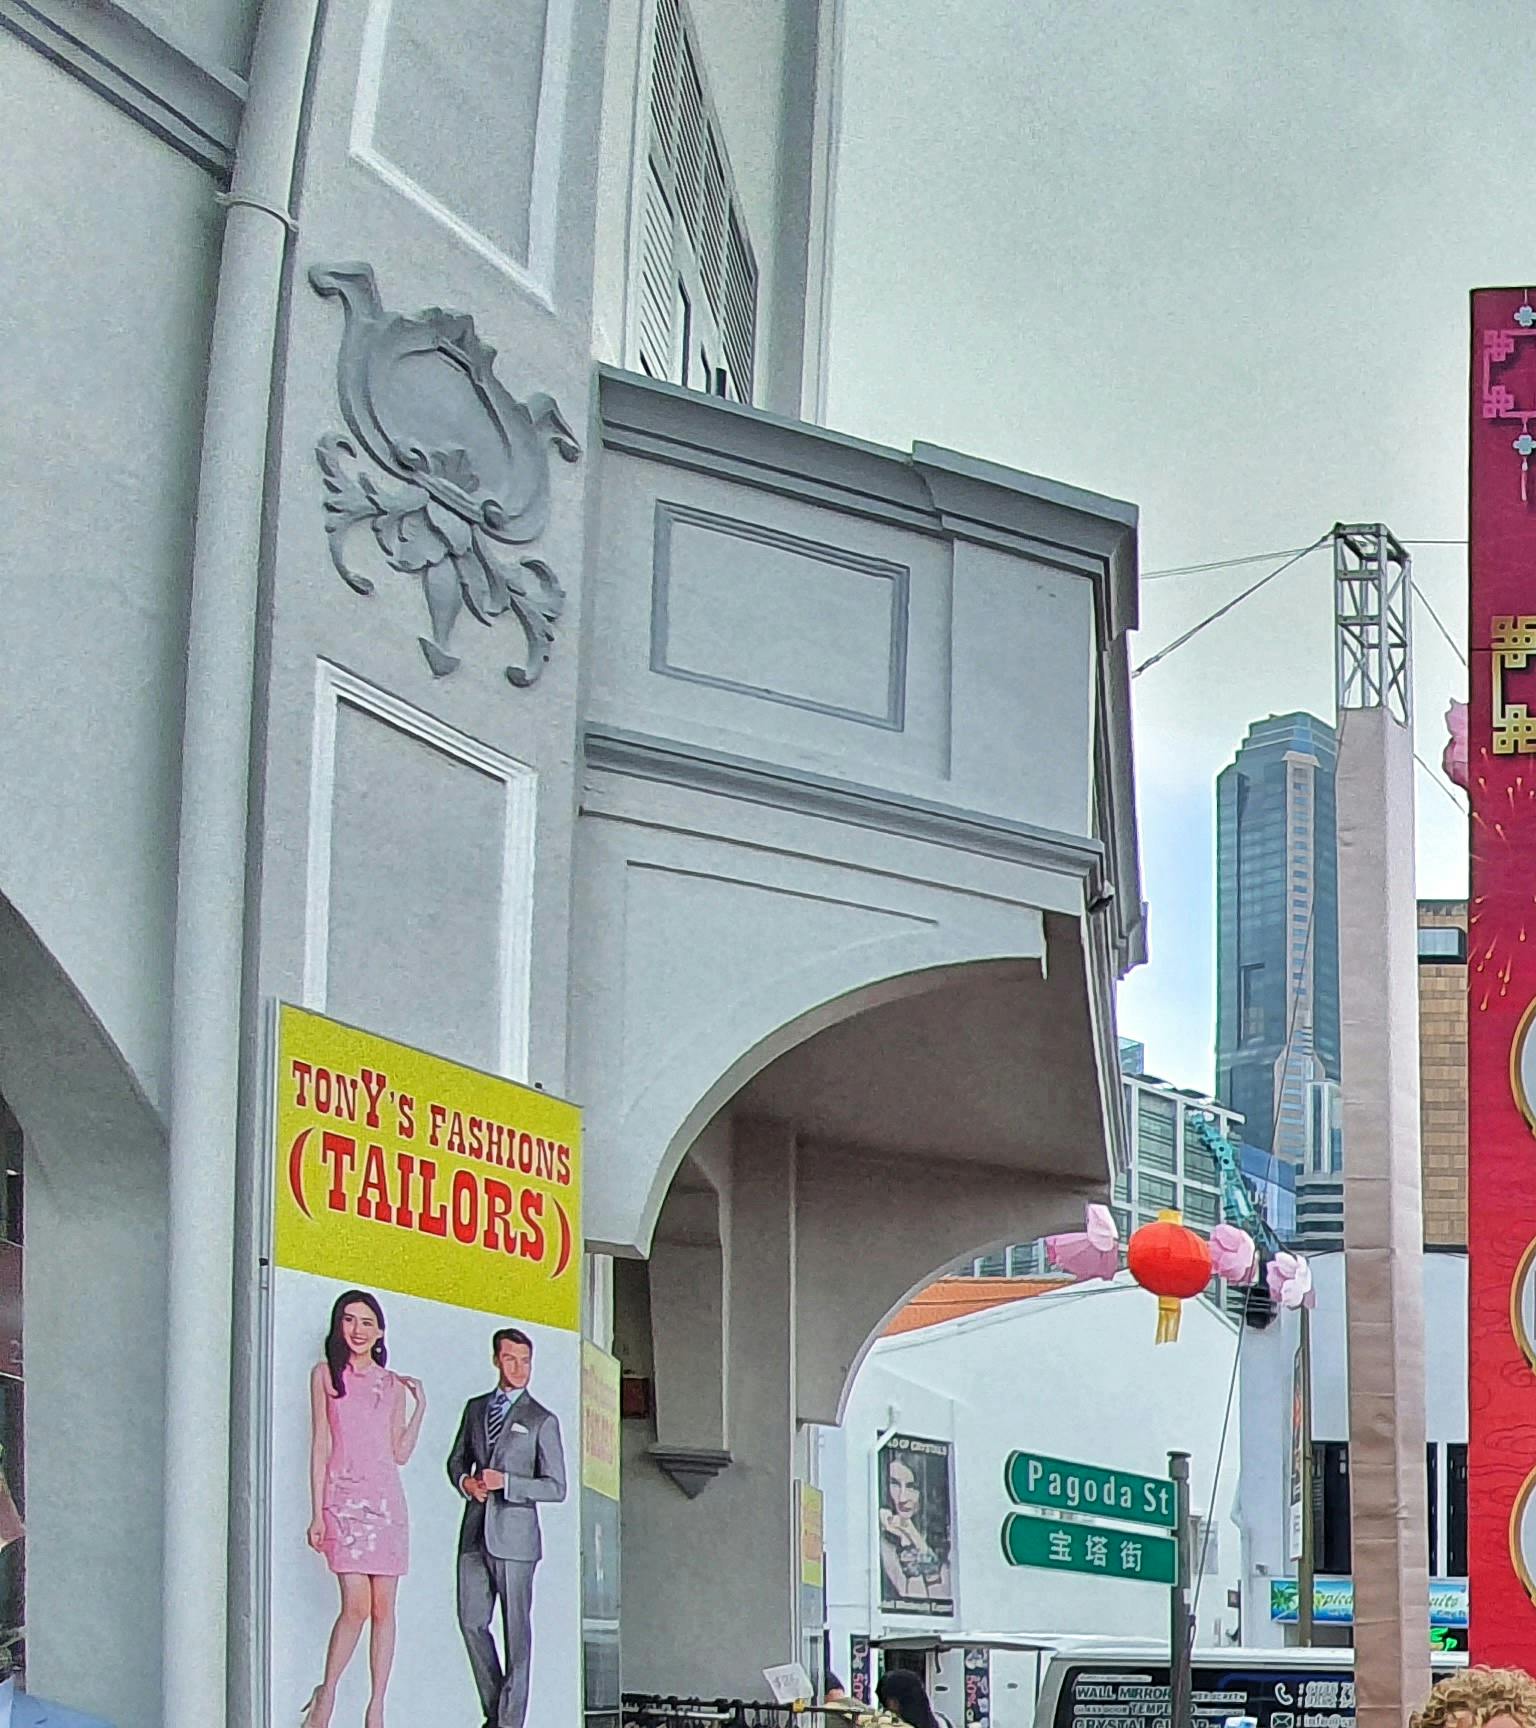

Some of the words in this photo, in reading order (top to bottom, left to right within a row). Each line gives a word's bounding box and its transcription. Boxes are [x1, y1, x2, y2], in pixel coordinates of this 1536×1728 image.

[293, 1059, 415, 1139] TONY'S
[429, 1104, 571, 1186] FASHIONS
[1028, 1459, 1132, 1508] Pagoda
[1143, 1482, 1169, 1515] St
[1048, 1529, 1143, 1572] 宝塔街
[1075, 1685, 1116, 1700] WALL
